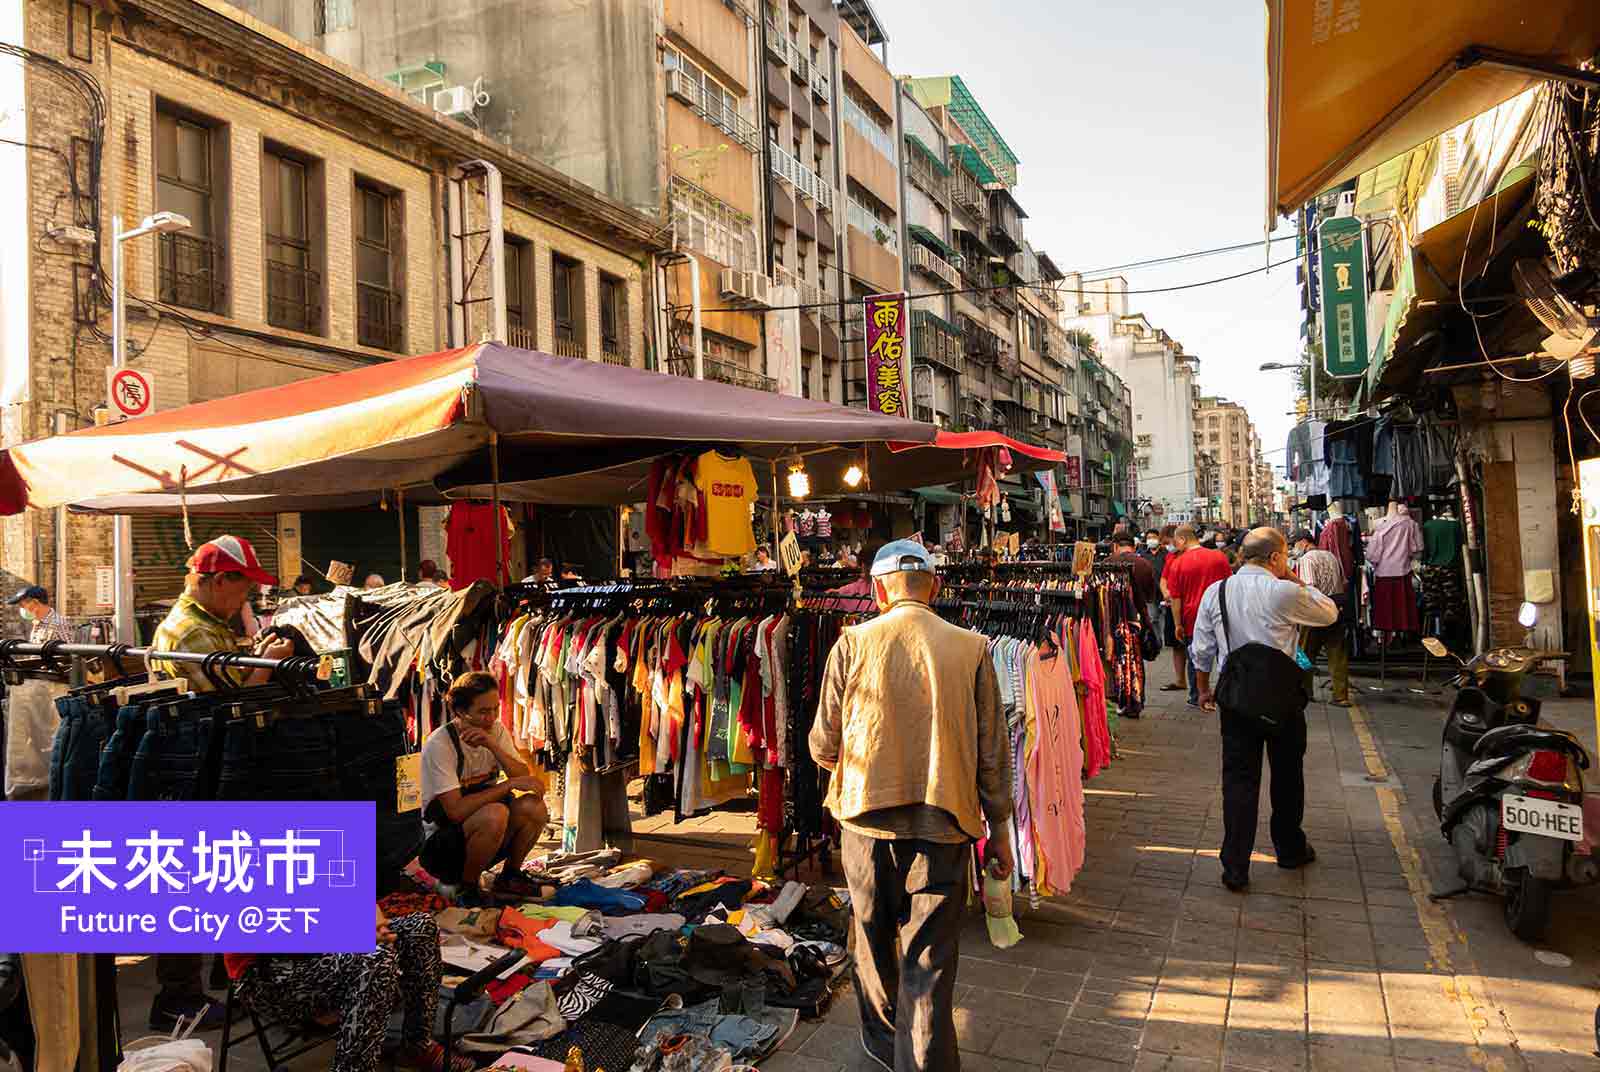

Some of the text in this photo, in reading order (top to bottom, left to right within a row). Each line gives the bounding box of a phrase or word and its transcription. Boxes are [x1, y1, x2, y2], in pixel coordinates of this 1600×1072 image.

[870, 300, 904, 414] 雨佑美容
[784, 539, 800, 570] 100
[1505, 806, 1581, 835] 500-HEE
